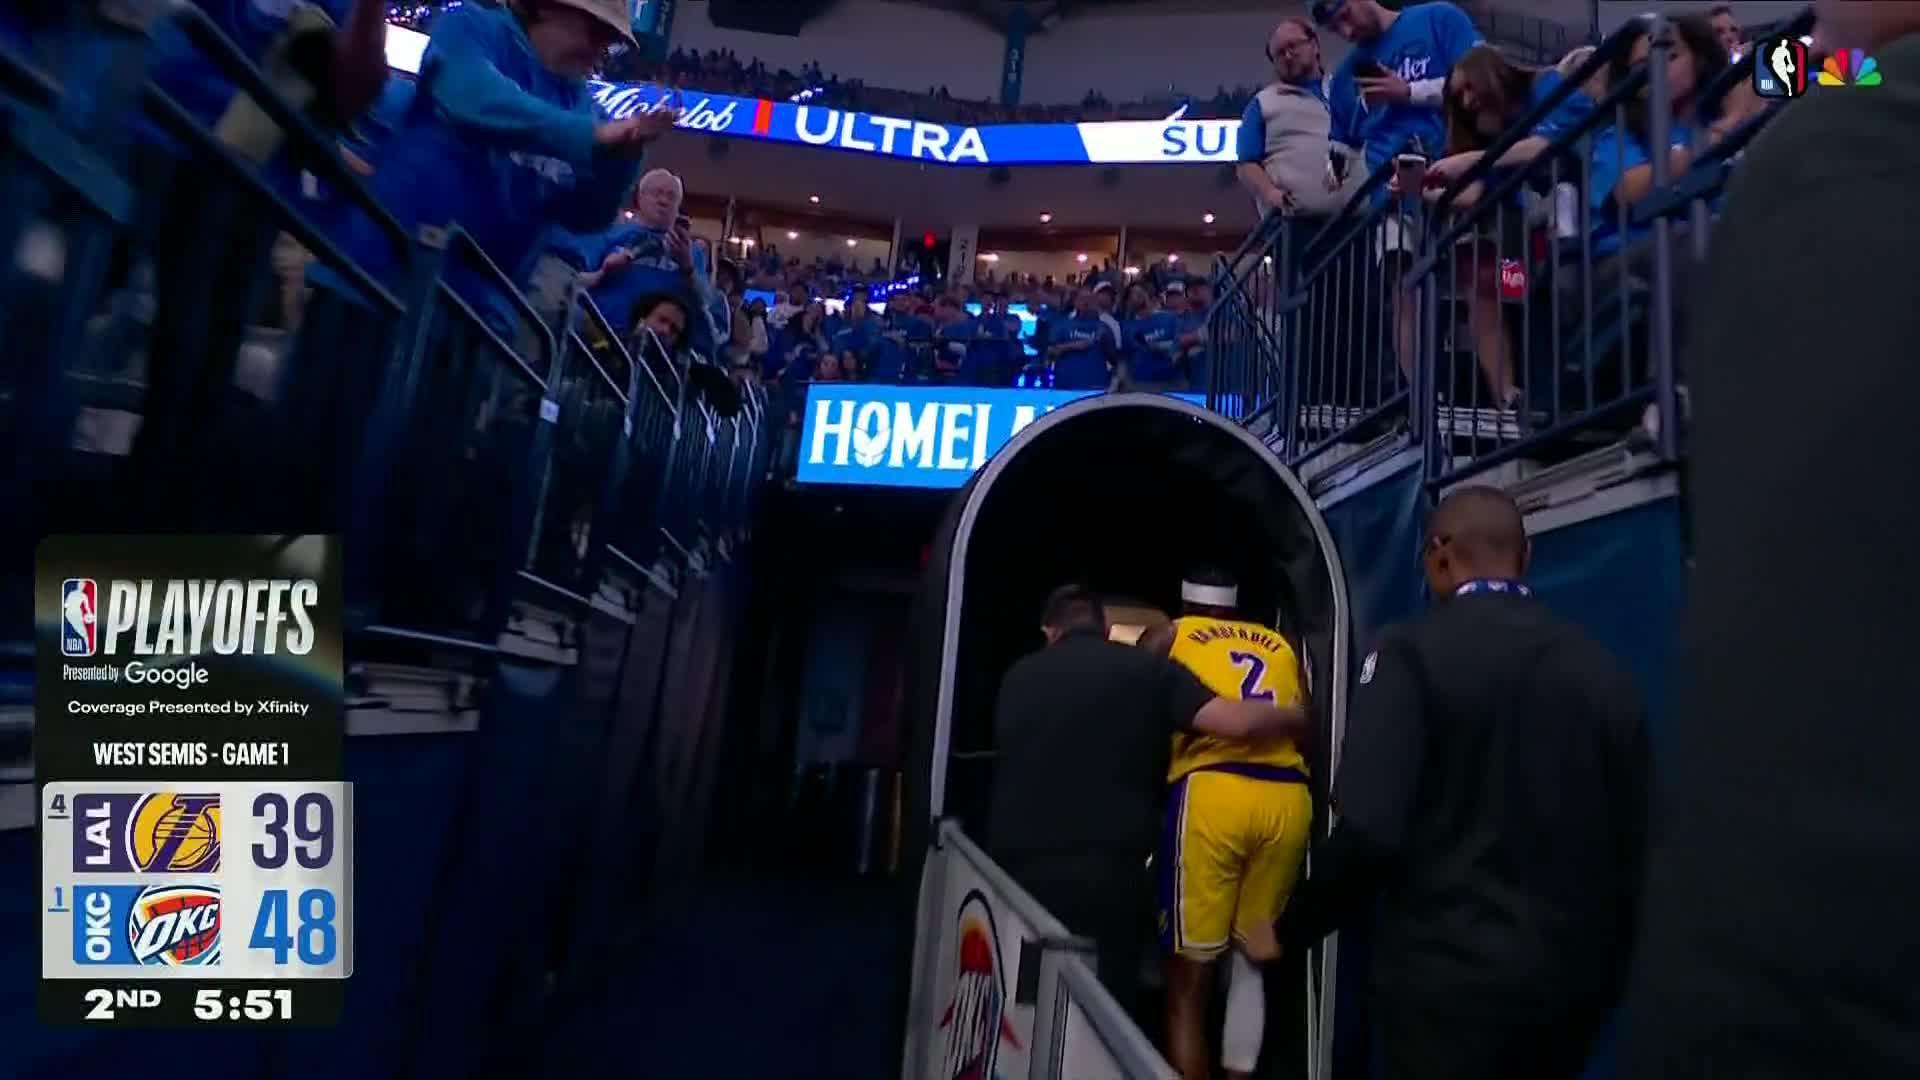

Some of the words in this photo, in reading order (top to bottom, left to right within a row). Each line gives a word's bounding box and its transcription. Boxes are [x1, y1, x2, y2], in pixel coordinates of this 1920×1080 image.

[795, 106, 989, 162] ULTRA
[1162, 125, 1242, 156] SU
[1229, 650, 1275, 701] 2
